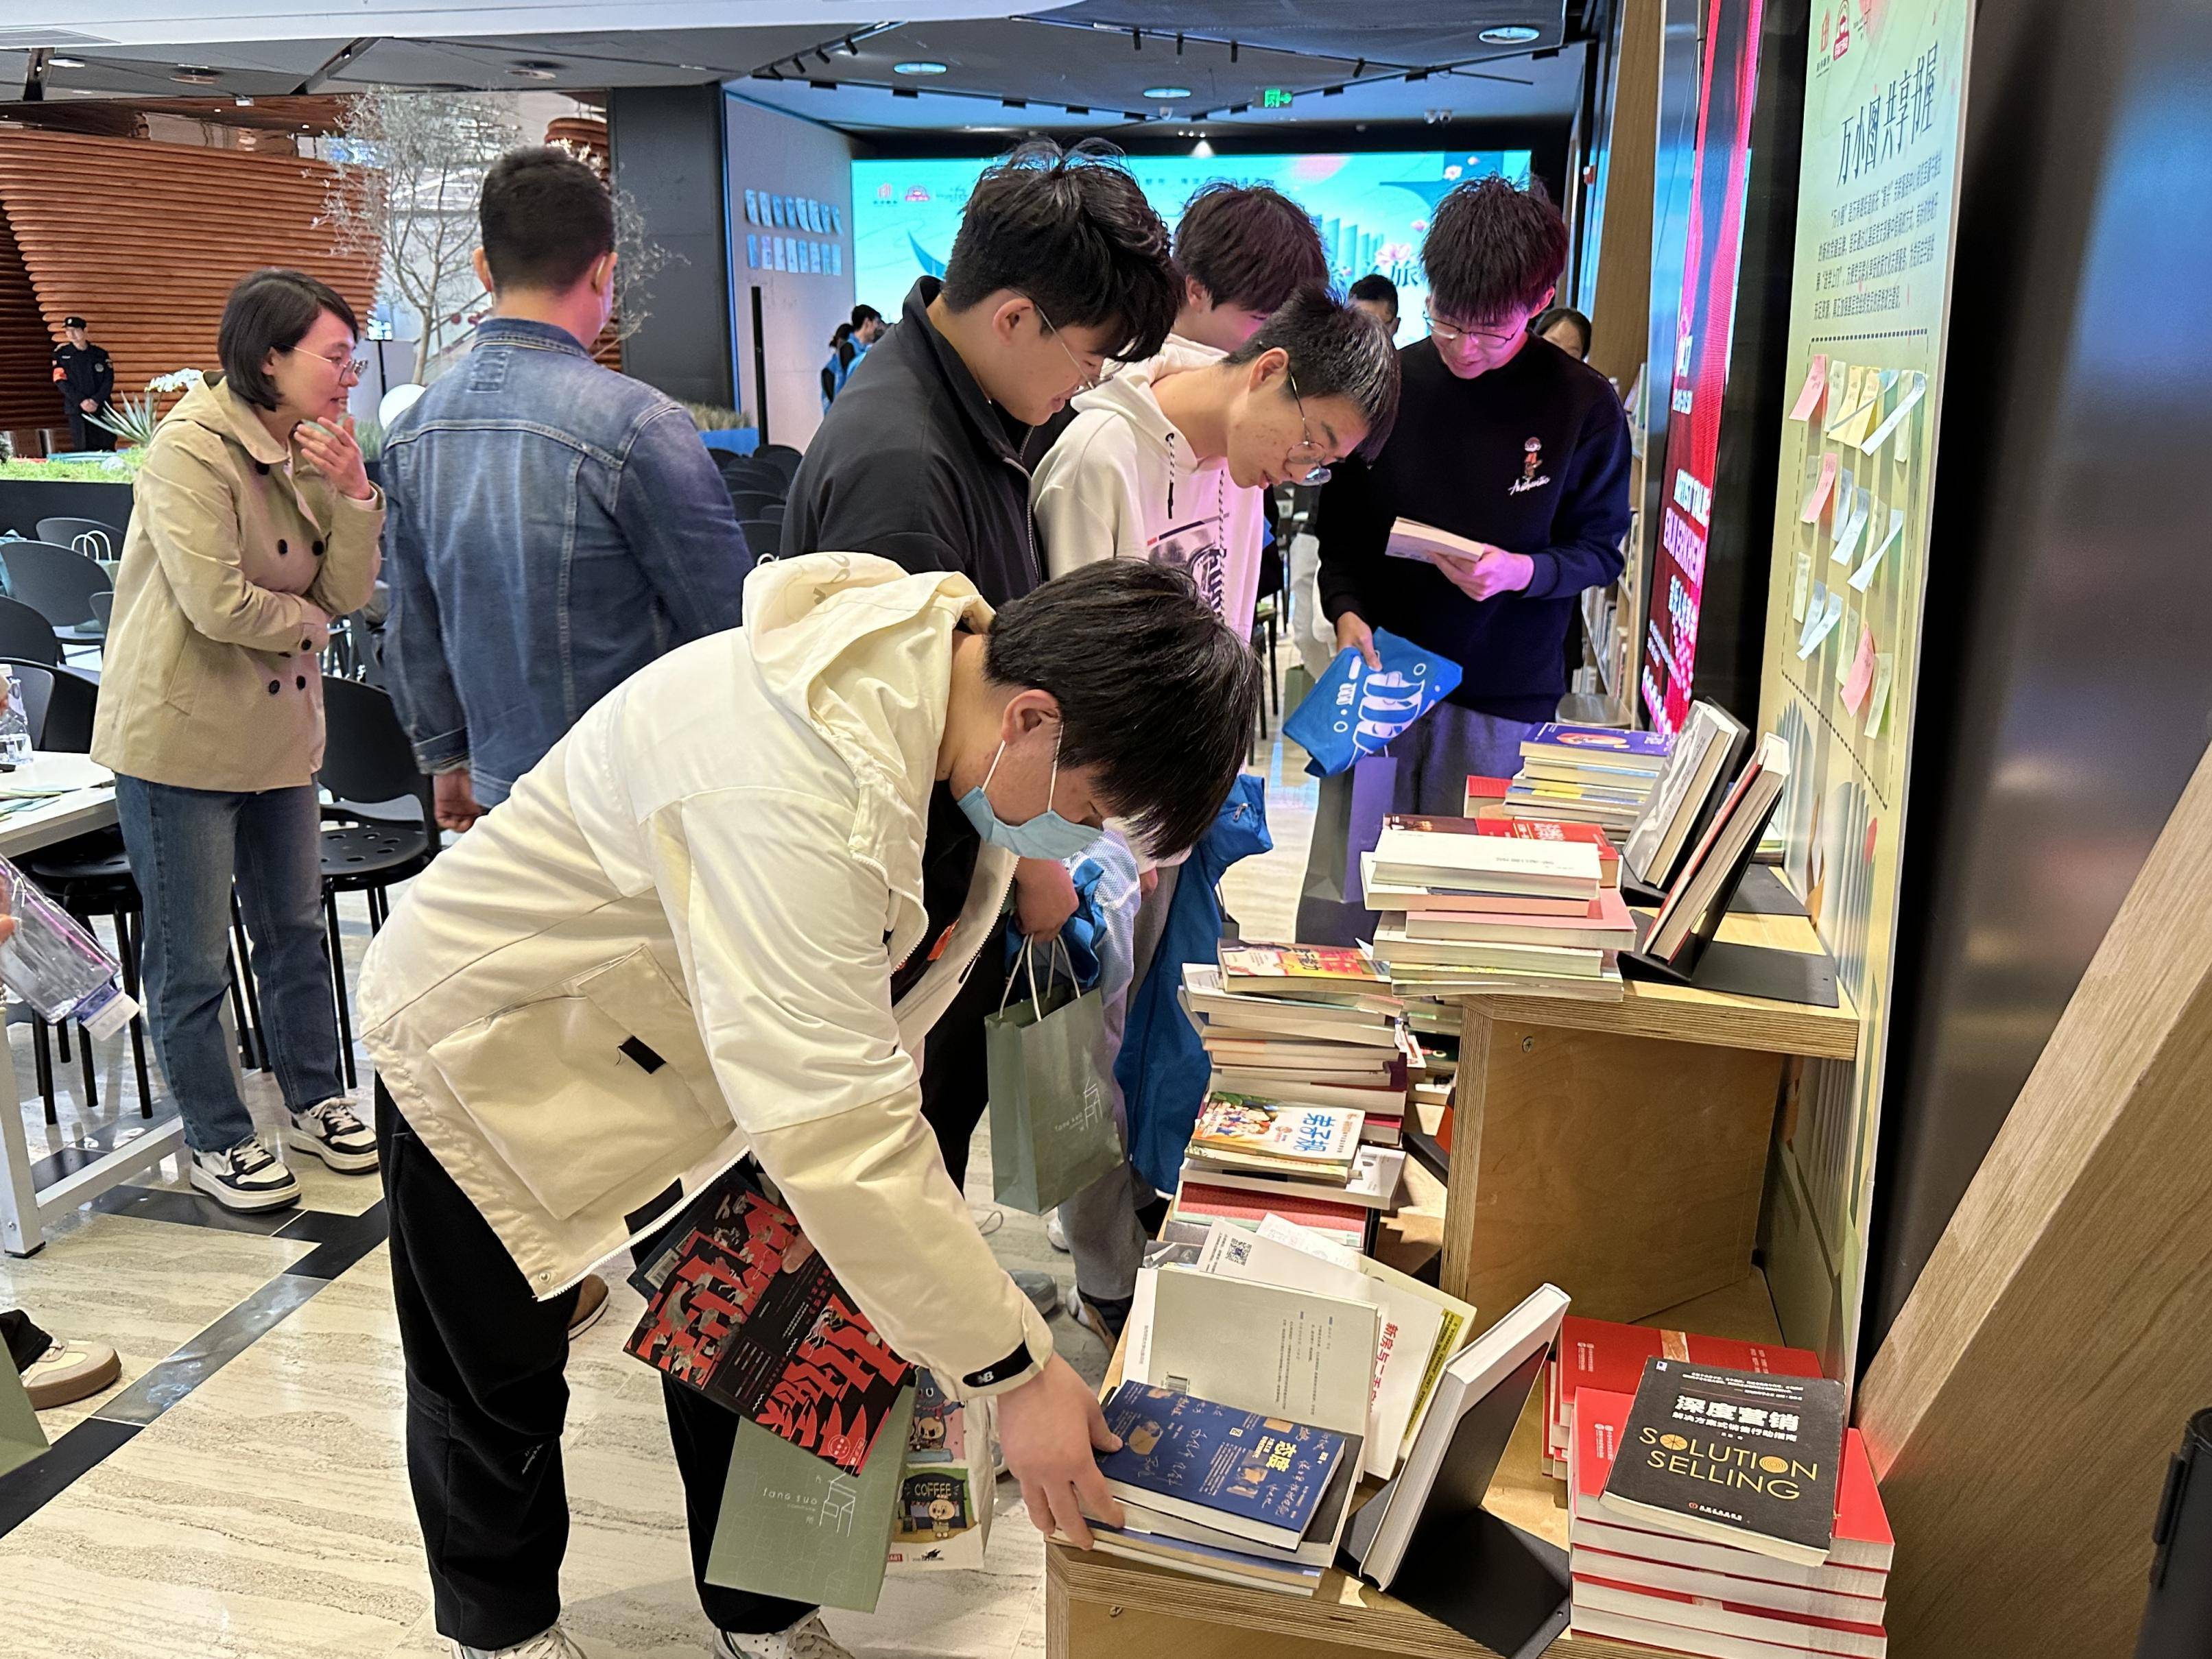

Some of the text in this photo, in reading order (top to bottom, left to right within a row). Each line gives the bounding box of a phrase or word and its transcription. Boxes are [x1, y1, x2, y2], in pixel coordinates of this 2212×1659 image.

[1837, 39, 1939, 187] 万小图共享书屋
[1294, 1112, 1336, 1152] 弟子规
[1674, 1395, 1800, 1432] 深度营销
[1265, 1440, 1296, 1472] 态度
[1639, 1427, 1818, 1481] SOLUTION
[914, 1482, 952, 1496] COFFEE
[1647, 1450, 1800, 1500] SELLING
